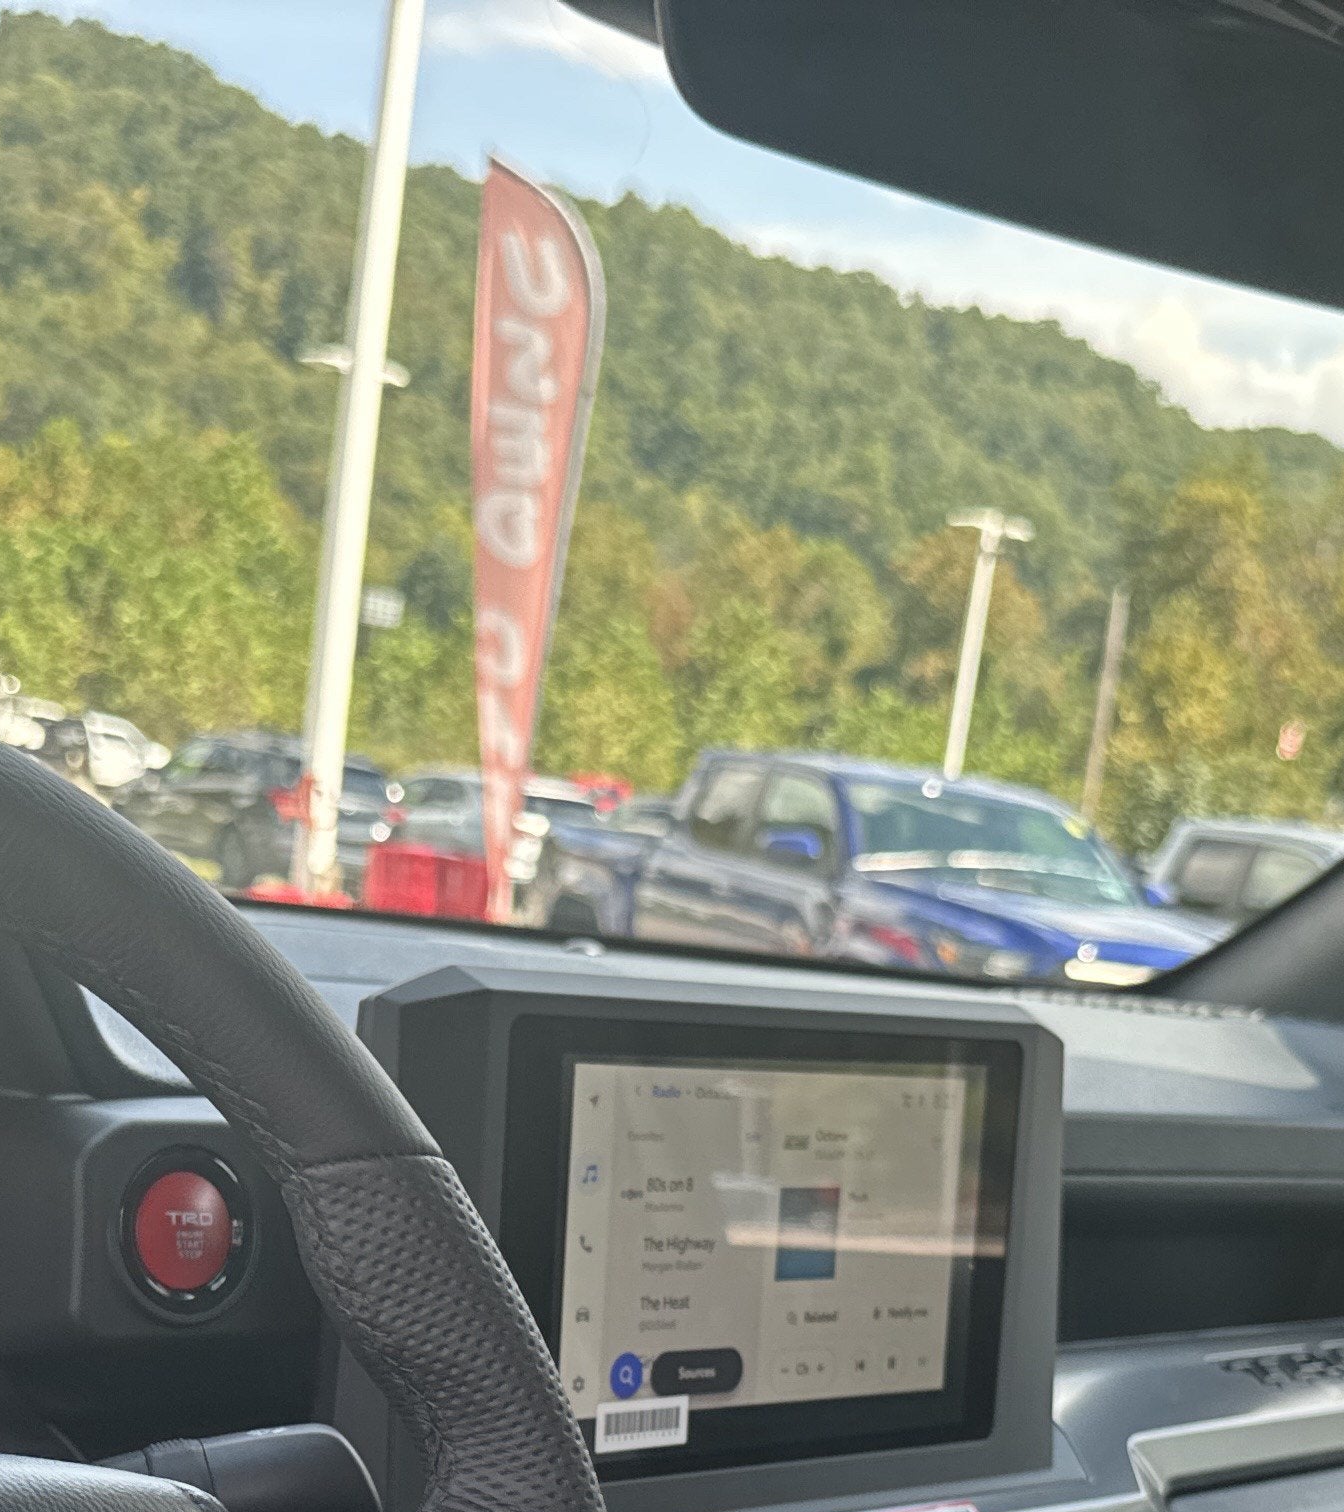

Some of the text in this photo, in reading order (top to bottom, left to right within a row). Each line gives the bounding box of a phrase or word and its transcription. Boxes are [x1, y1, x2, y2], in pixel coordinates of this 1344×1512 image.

[164, 1211, 213, 1226] TRD
[644, 1238, 716, 1256] The Highway
[641, 1296, 690, 1310] The Heat
